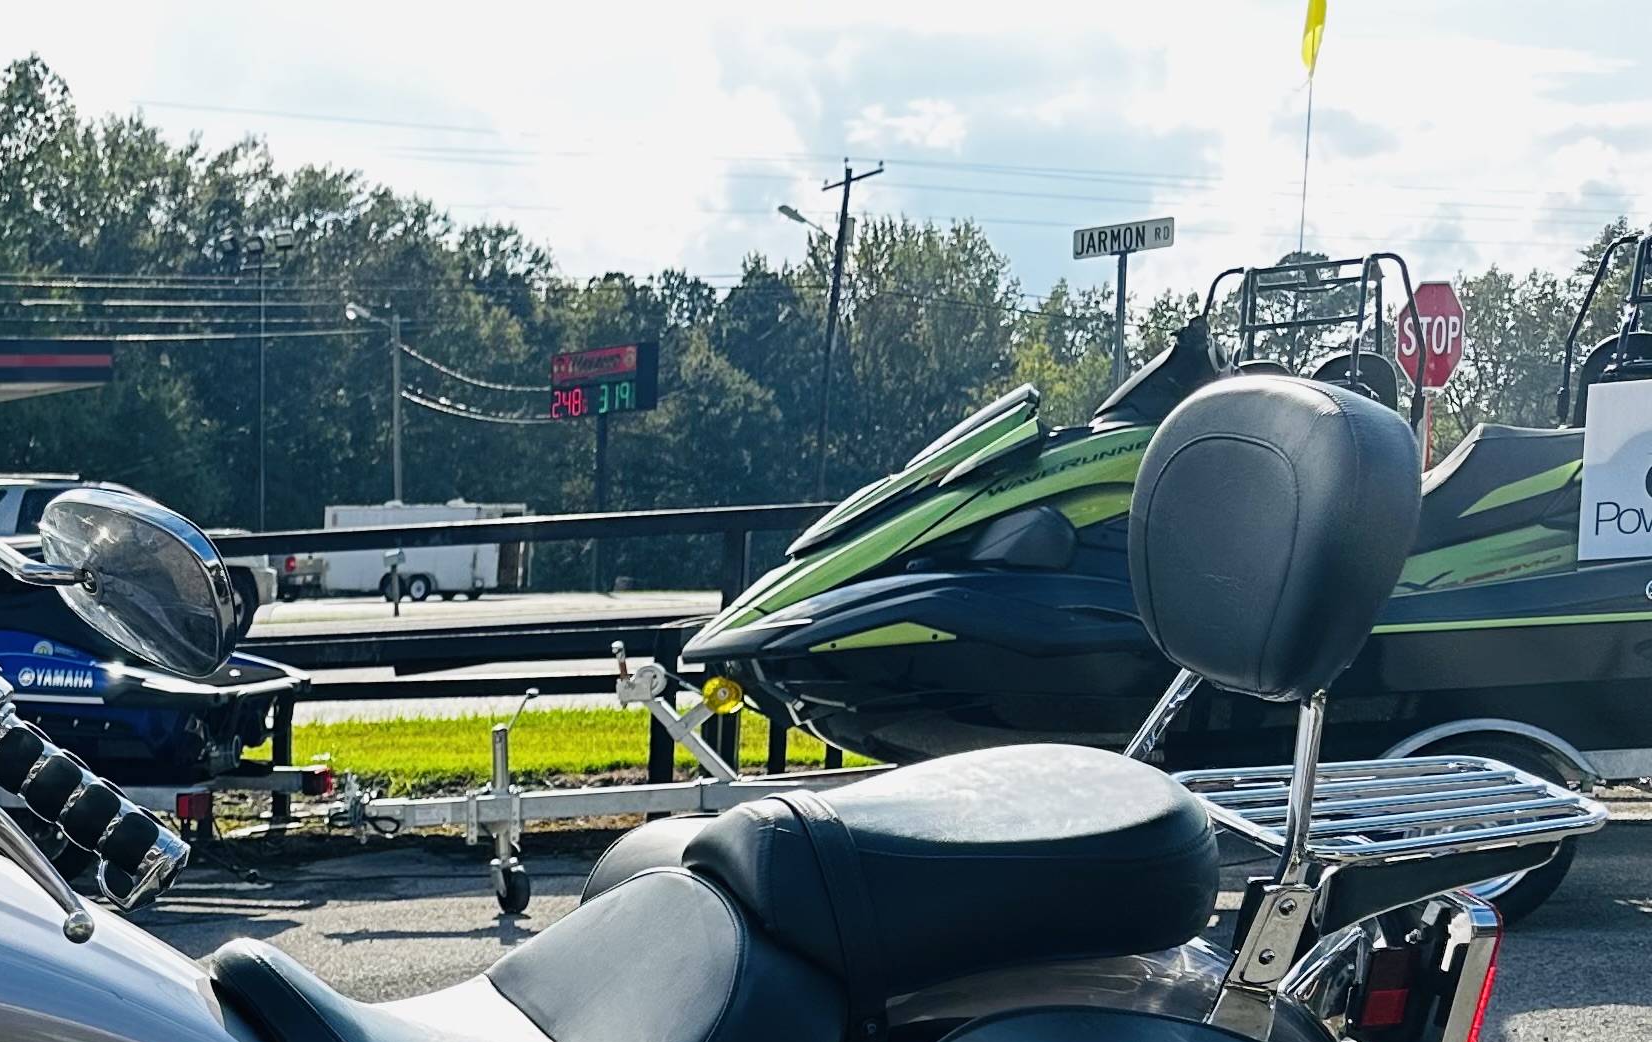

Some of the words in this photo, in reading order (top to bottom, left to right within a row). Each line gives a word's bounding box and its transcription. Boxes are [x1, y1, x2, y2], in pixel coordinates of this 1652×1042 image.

[1075, 225, 1146, 256] JARMON
[1154, 226, 1170, 241] RD
[1401, 315, 1461, 356] STOP
[36, 668, 94, 688] YAMAHA
